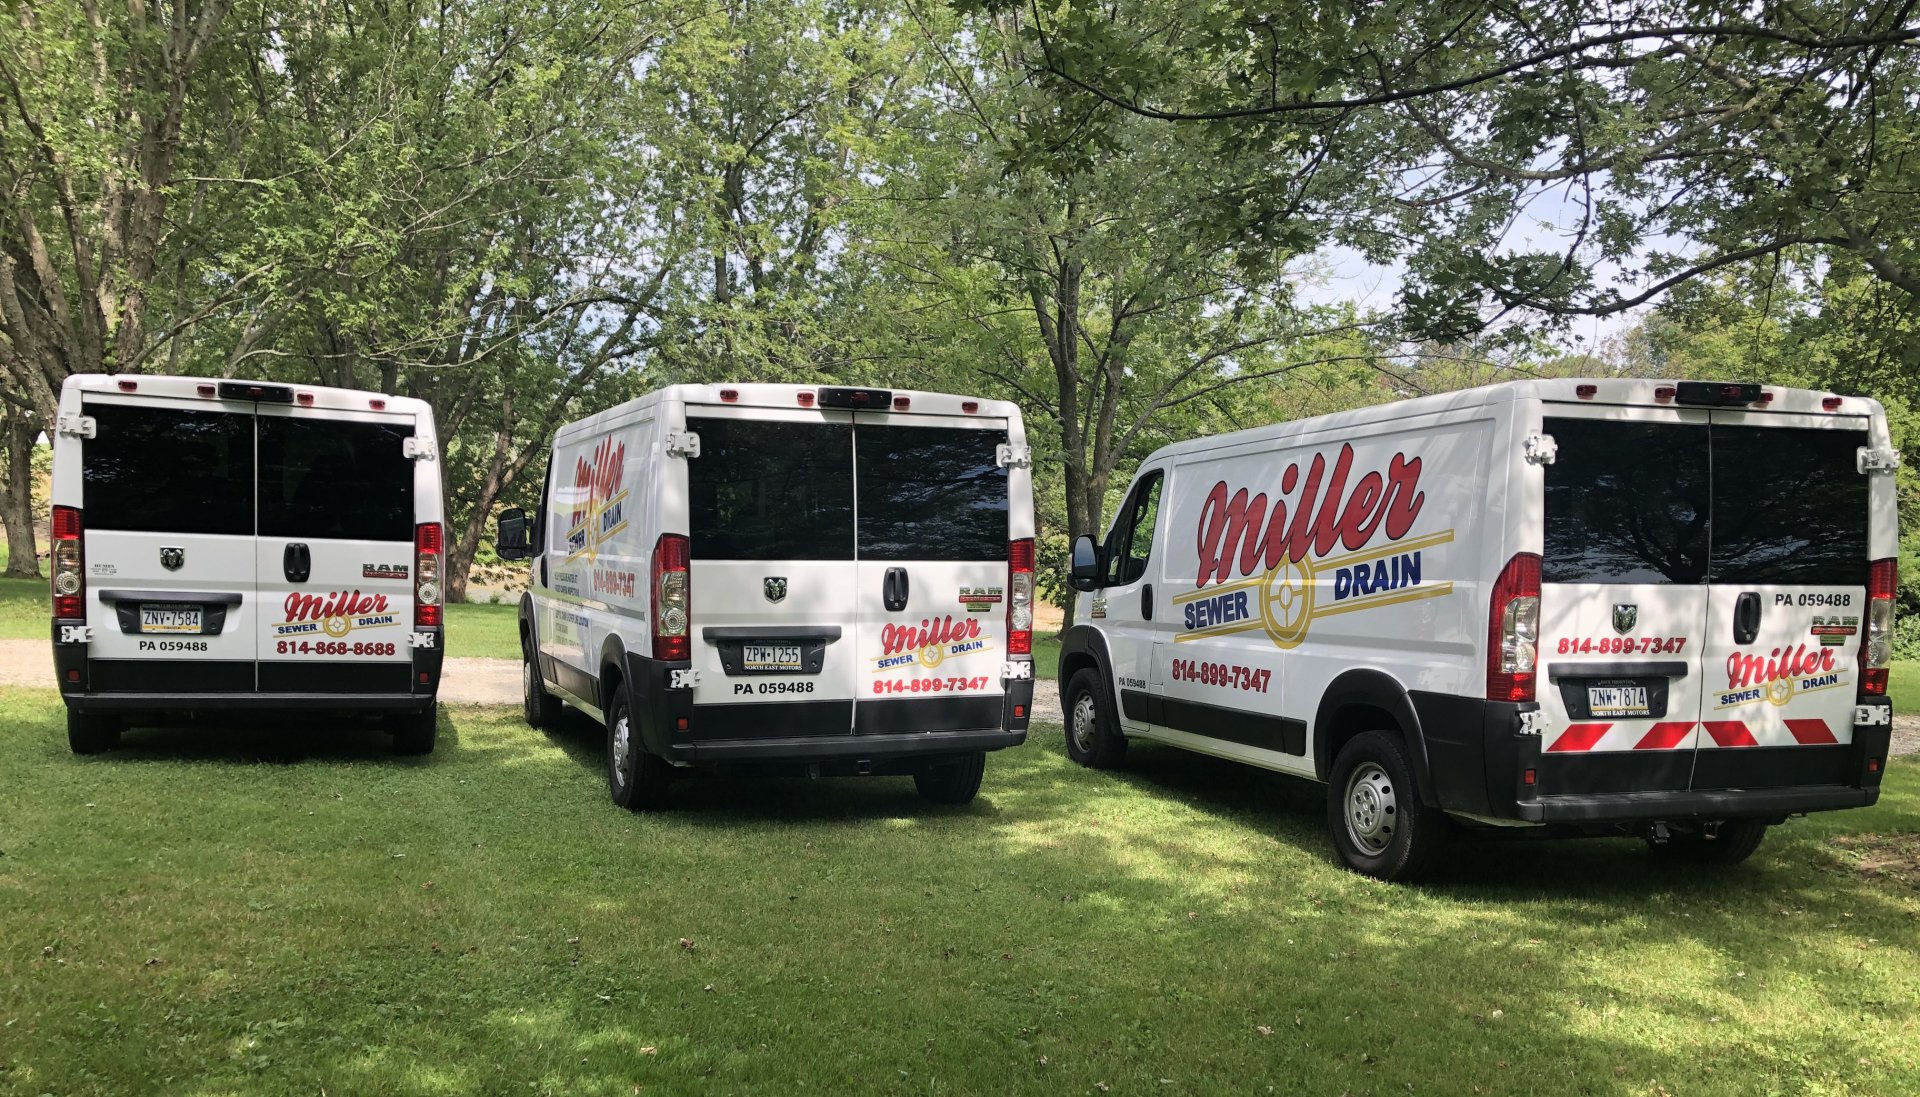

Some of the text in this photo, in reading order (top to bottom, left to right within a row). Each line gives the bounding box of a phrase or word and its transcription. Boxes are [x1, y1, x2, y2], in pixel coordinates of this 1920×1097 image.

[572, 433, 625, 528] Miller
[568, 500, 622, 555] SEWER DRAIN
[1196, 442, 1425, 588] Miller
[284, 589, 389, 622] Miller
[1184, 552, 1422, 630] SEWER DRAIN
[1775, 594, 1851, 607] PA 059488
[277, 615, 393, 635] SEWER DRAIN
[881, 615, 981, 655] Miller
[1812, 616, 1858, 625] RAM
[139, 641, 208, 652] PA 059488
[276, 640, 396, 656] 814-868-8688
[877, 640, 983, 669] SEWER DRAIN
[1557, 637, 1687, 654] 814-899-7347
[1171, 658, 1272, 693] 814-899-7347
[1727, 643, 1835, 690] Miller
[734, 682, 814, 694] PA 059488
[873, 676, 989, 694] 814-899-7347
[1118, 677, 1126, 686] PA
[1721, 674, 1838, 705] SEWER DRAIN
